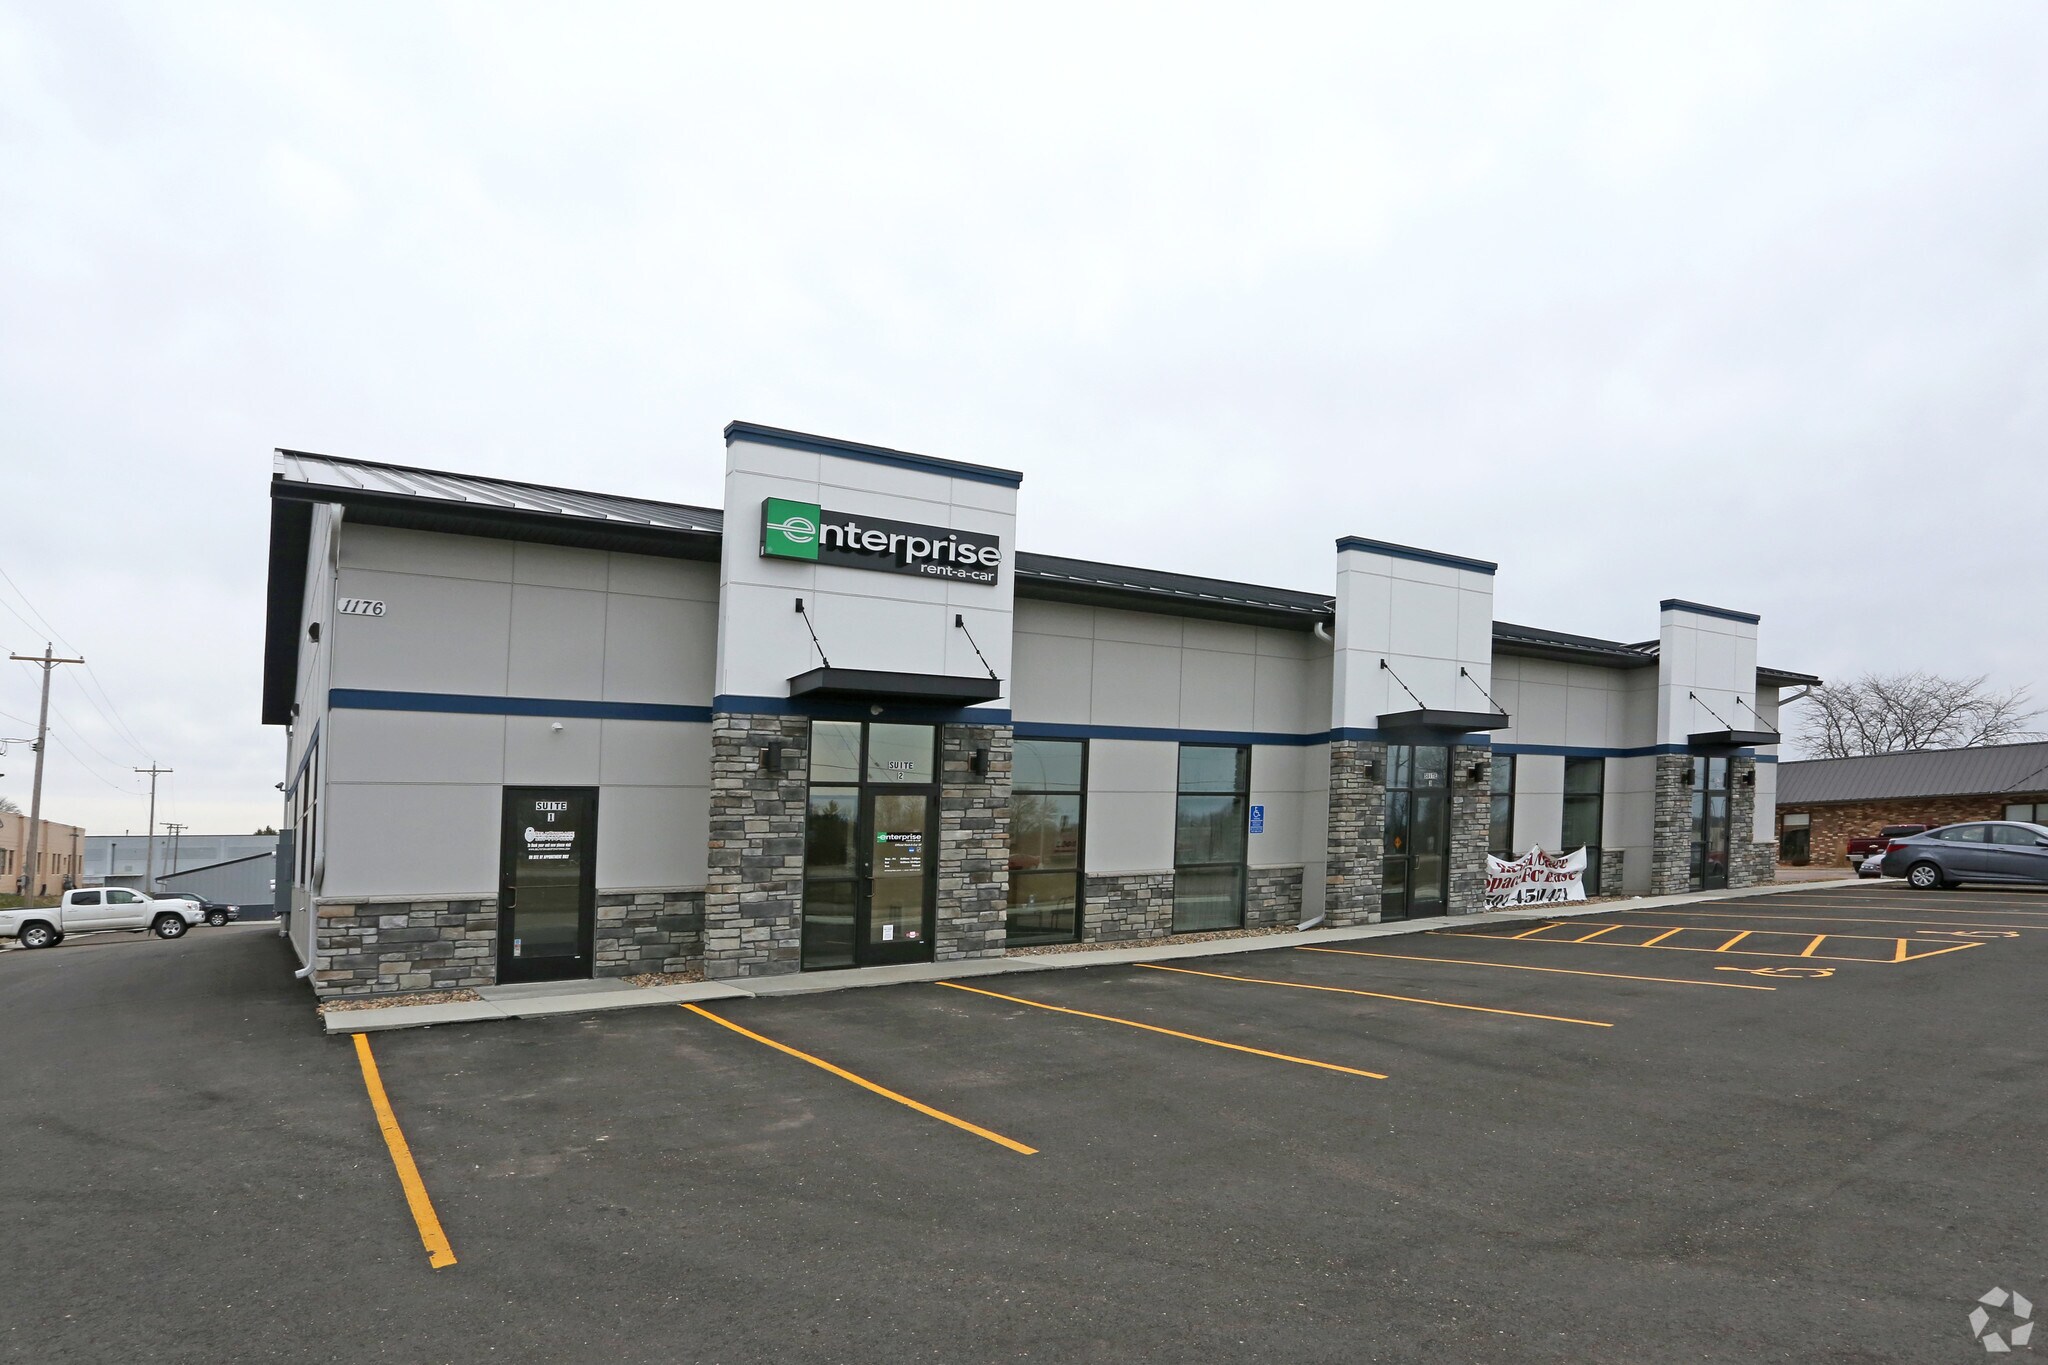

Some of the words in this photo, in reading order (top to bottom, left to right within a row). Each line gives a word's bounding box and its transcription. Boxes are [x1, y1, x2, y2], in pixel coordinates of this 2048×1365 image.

[767, 517, 1002, 567] enterprise
[920, 562, 995, 583] rent-a-car
[342, 600, 383, 615] 1176
[889, 761, 914, 770] SUITE
[536, 802, 567, 810] SUITE
[877, 833, 922, 841] enterprise
